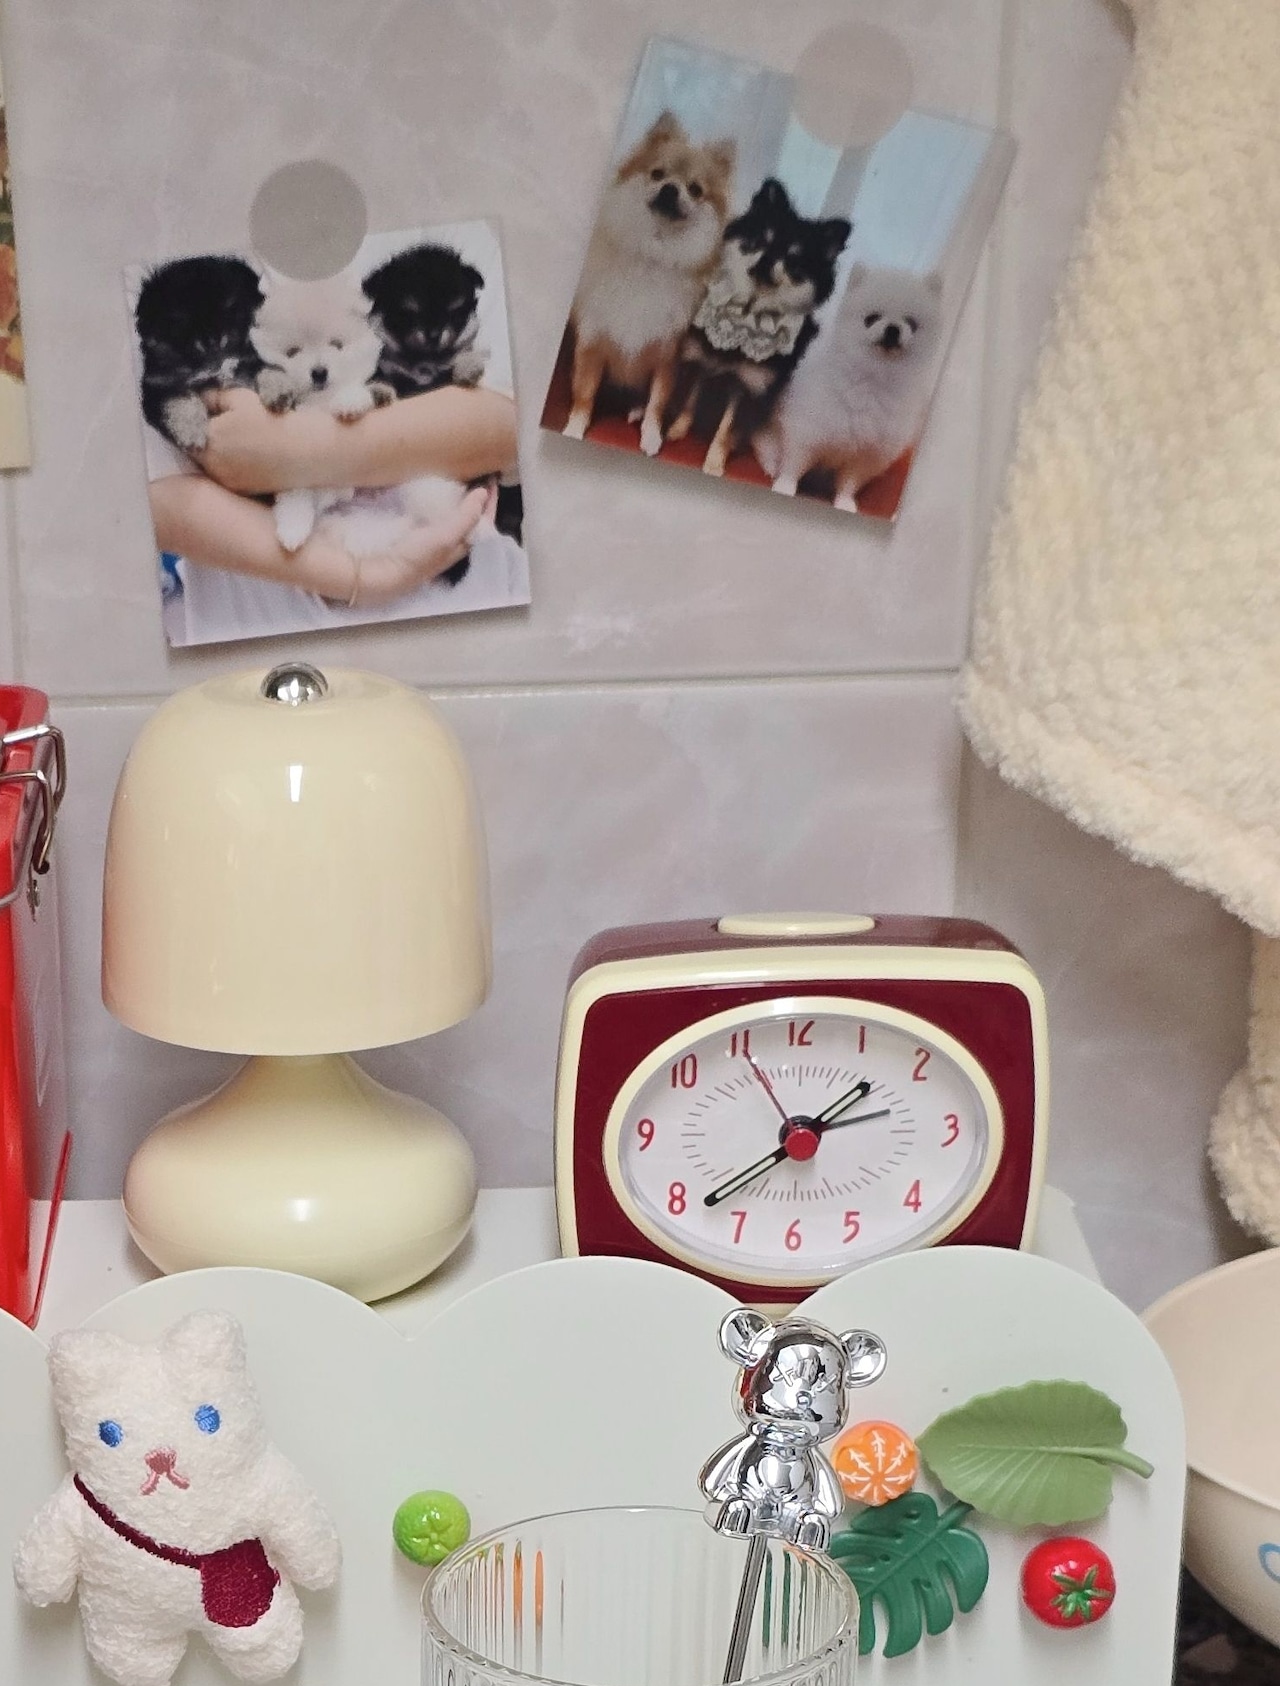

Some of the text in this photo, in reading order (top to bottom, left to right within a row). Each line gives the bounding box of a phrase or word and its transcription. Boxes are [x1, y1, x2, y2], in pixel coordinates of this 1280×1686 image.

[730, 1029, 751, 1058] 11
[787, 1019, 816, 1047] 12
[857, 1025, 867, 1054] 1
[670, 1053, 699, 1089] 10
[911, 1047, 932, 1082] 2
[637, 1118, 656, 1152] 9
[940, 1113, 960, 1148] 3
[667, 1181, 688, 1216] 8
[902, 1179, 923, 1213] 4
[730, 1211, 748, 1244] 7
[784, 1218, 802, 1252] 6
[842, 1210, 861, 1244] 5
